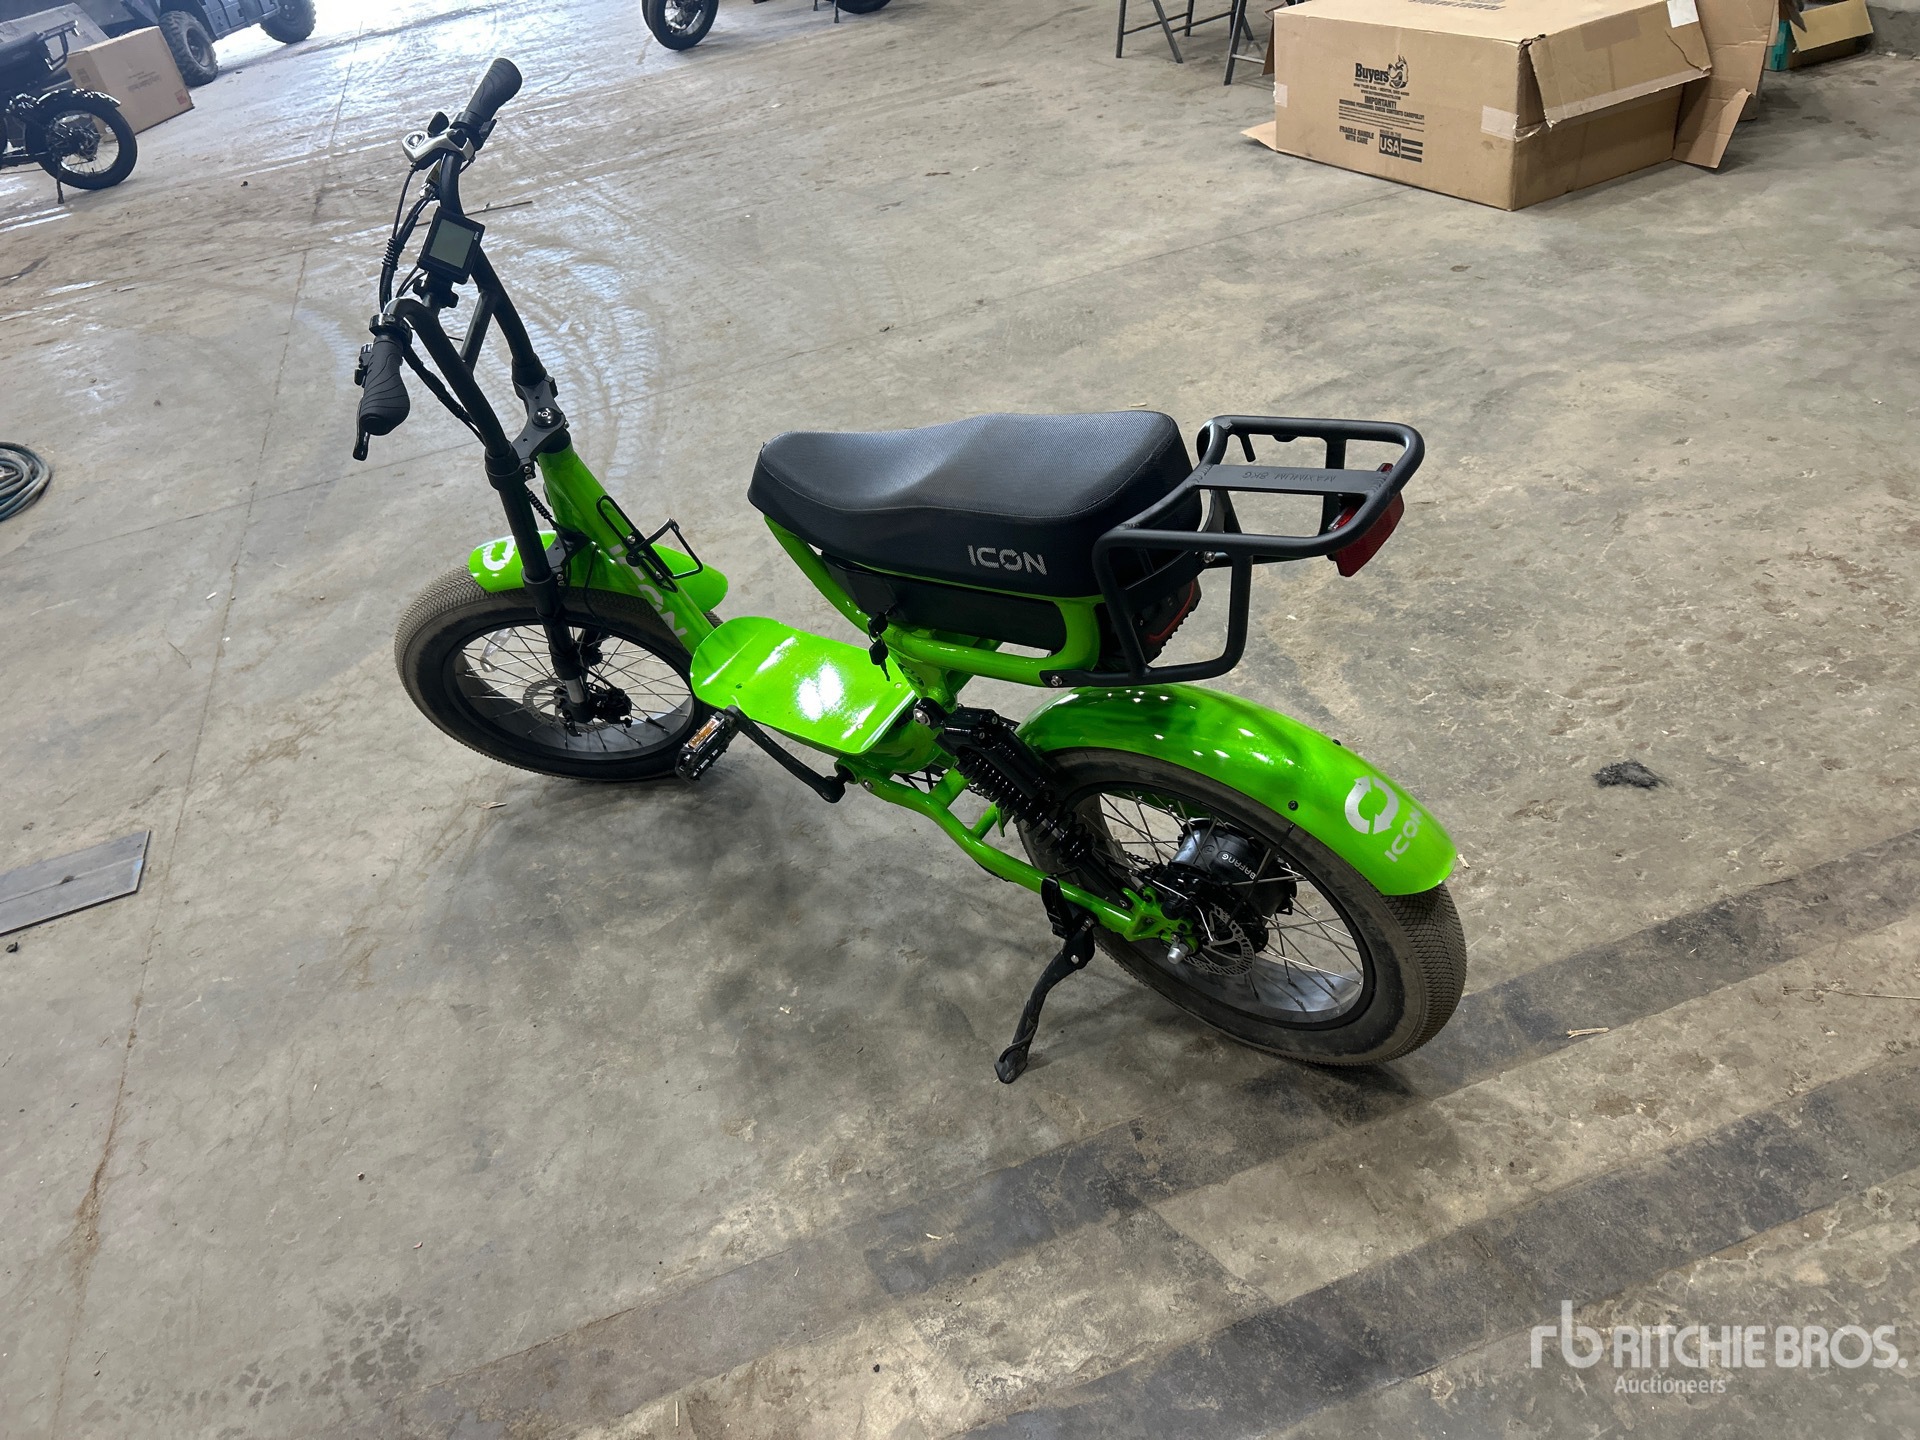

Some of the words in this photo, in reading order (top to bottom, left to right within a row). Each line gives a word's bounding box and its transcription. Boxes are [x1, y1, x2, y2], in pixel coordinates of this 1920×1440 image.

[1355, 63, 1390, 83] Buyers
[1339, 126, 1356, 135] FRAGILE
[1357, 129, 1375, 139] HANDLE
[1345, 134, 1356, 142] WITH
[1357, 136, 1368, 145] CARE
[1380, 137, 1400, 155] USA
[967, 544, 1048, 576] ICON
[1221, 853, 1257, 880] BAFANG
